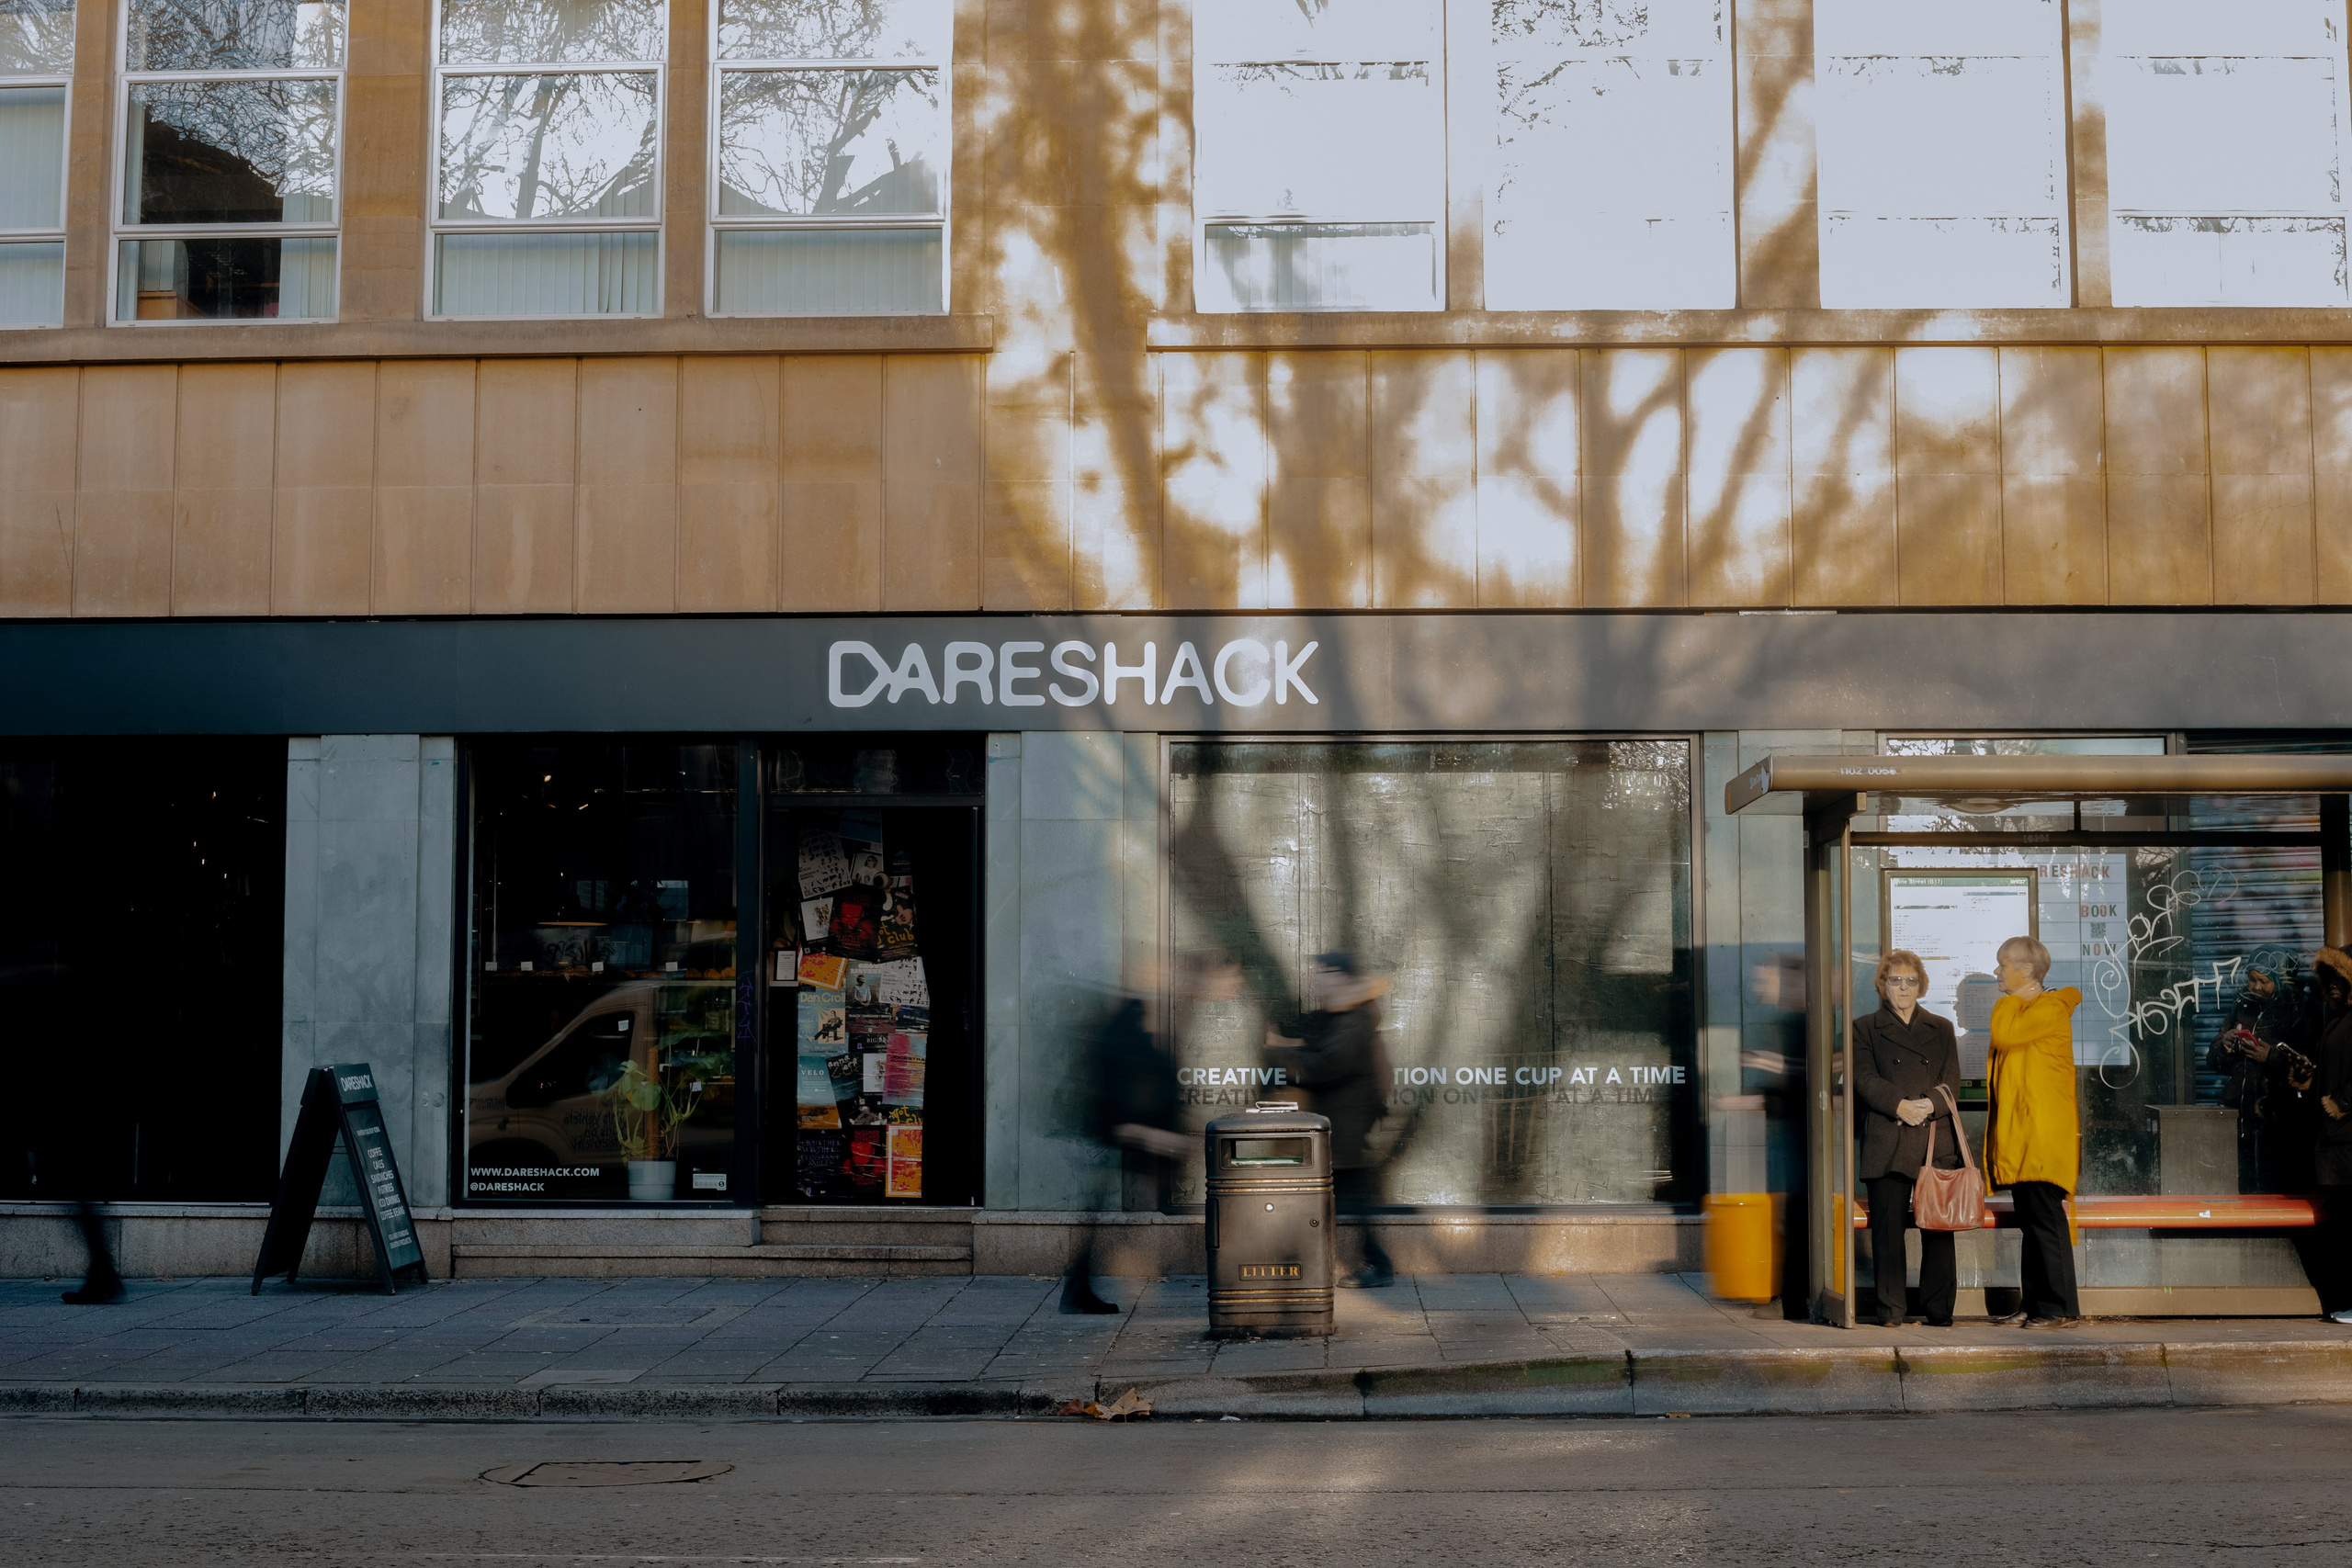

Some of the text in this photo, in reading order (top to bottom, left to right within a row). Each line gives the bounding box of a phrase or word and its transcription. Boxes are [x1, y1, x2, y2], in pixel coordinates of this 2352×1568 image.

[829, 640, 1319, 707] DARESHACK
[1839, 767, 1862, 775] 1102
[2081, 905, 2117, 918] BOOK
[888, 928, 916, 944] club
[2082, 944, 2116, 956] NOW
[800, 992, 820, 1003] Dan
[828, 1055, 851, 1067] anna
[1177, 1067, 1287, 1086] CREATIVE
[1454, 1066, 1507, 1086] ONE
[1514, 1066, 1562, 1086] CUP
[1568, 1066, 1596, 1085] AT
[1605, 1066, 1622, 1085] A
[1628, 1066, 1687, 1085] TIME
[340, 1074, 374, 1092] DARESHACK
[469, 1168, 600, 1177] WWW.DARESHACK.COM
[469, 1182, 545, 1191] @DARESHACK
[1242, 1266, 1299, 1277] LITTER
